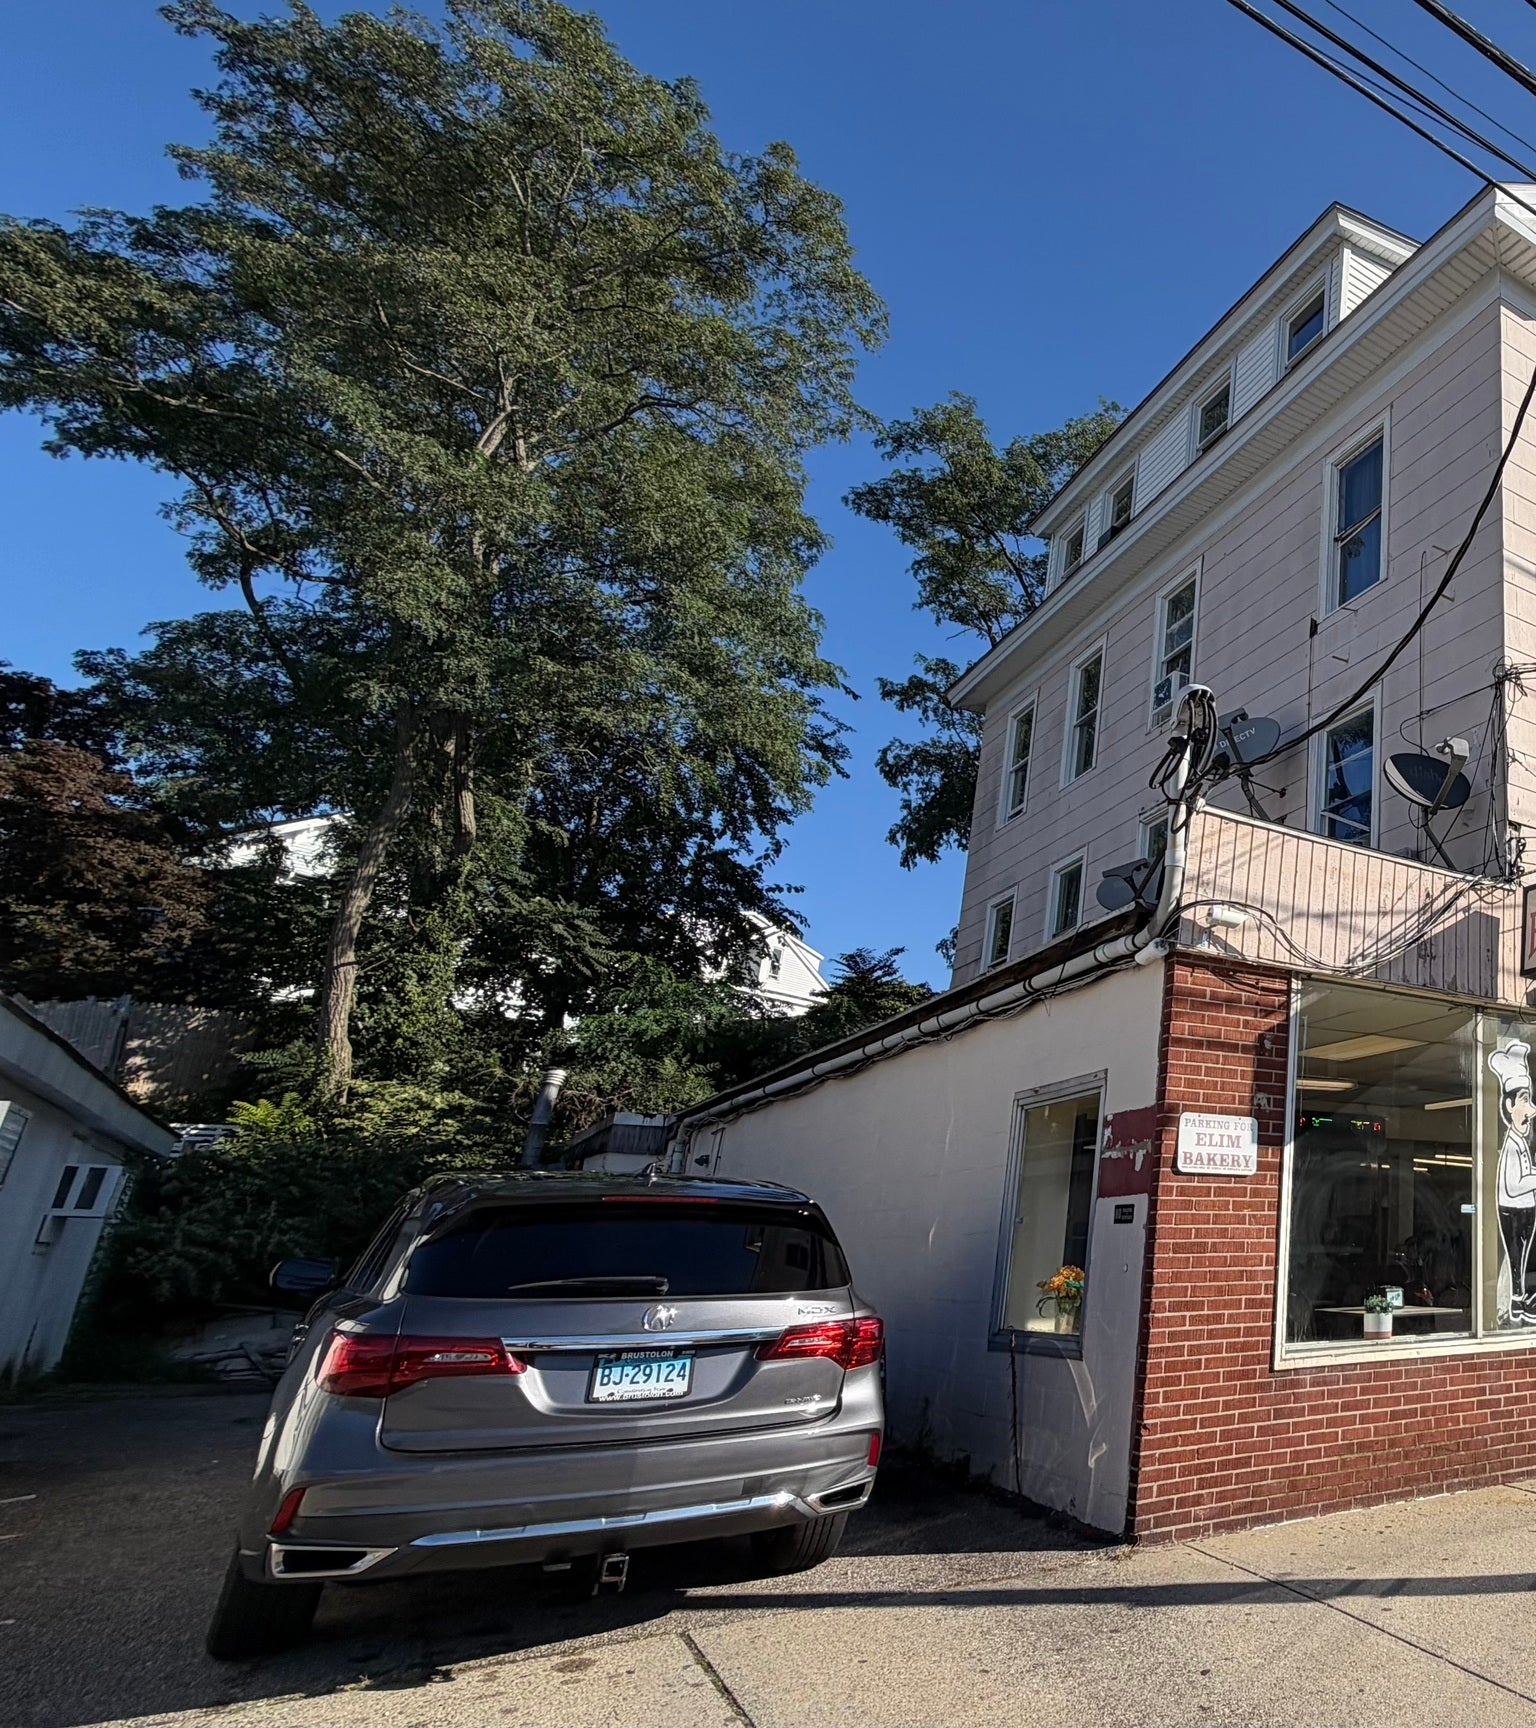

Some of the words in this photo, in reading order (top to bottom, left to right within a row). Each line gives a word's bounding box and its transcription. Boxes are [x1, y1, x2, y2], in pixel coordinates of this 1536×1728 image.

[1218, 726, 1256, 748] DIECTV
[1184, 1118, 1230, 1130] PARKING
[1234, 1121, 1253, 1132] FOR
[1195, 1132, 1242, 1148] ELIM
[1182, 1151, 1253, 1168] BAKERY
[621, 1350, 674, 1360] BRUSTOLON
